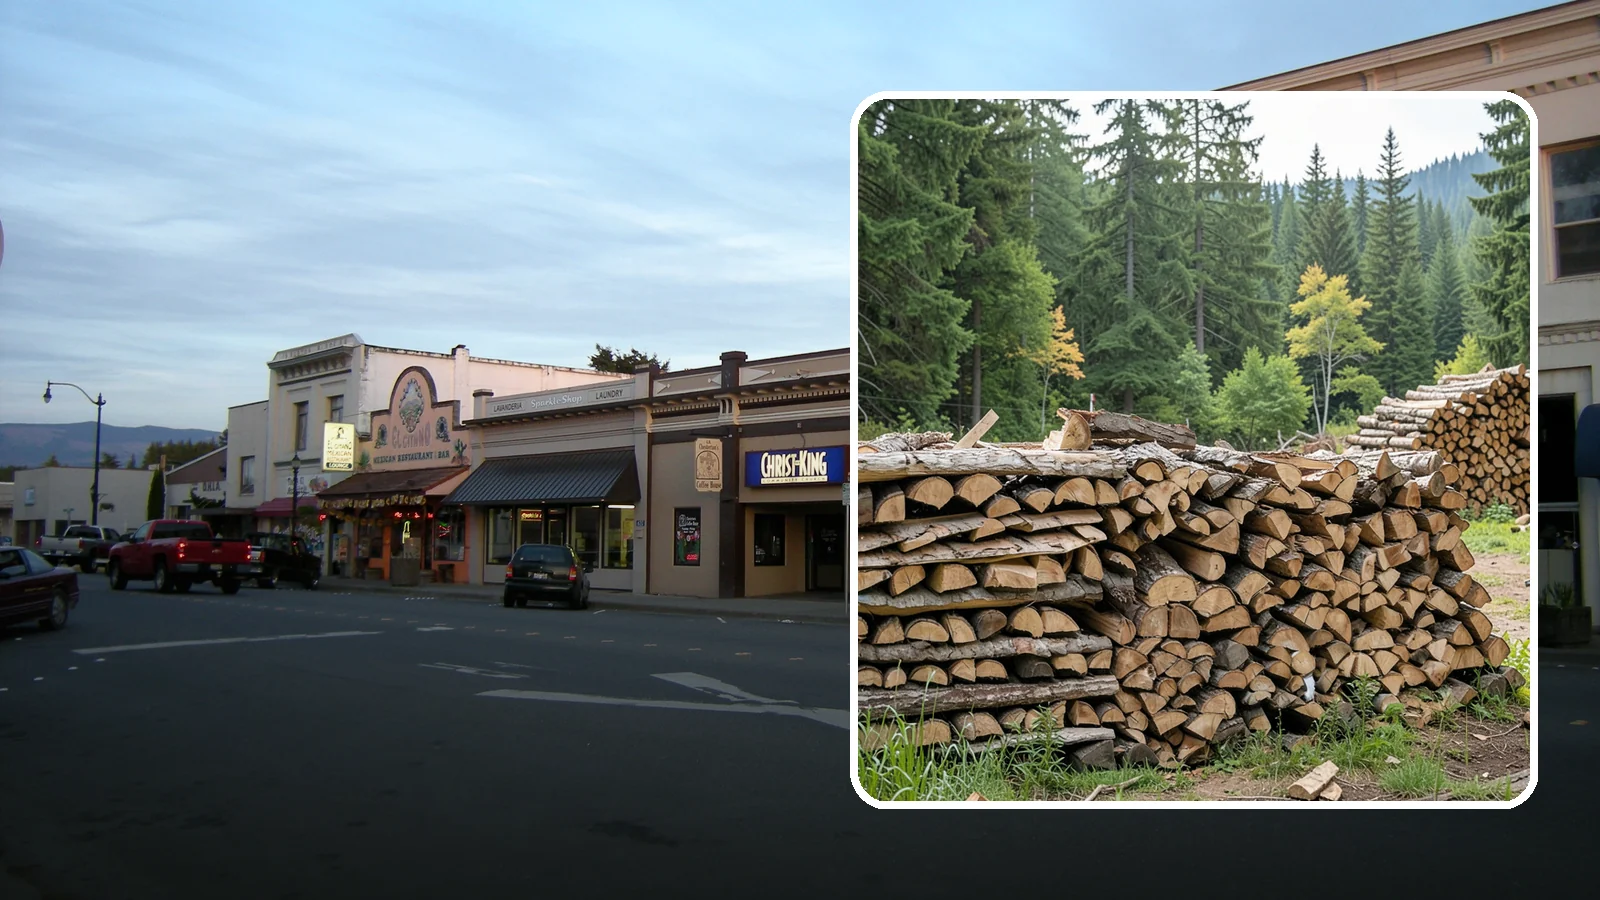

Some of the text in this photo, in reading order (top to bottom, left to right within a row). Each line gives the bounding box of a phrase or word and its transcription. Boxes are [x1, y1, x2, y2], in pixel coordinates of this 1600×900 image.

[530, 394, 583, 409] Sparkle Shop
[596, 389, 623, 400] LAUNDRY
[493, 402, 522, 412] LAVANDERIA
[392, 426, 403, 449] EL
[373, 449, 451, 464] MEXICAN RESTAURANT BAR
[761, 450, 828, 478] CHRIST KING
